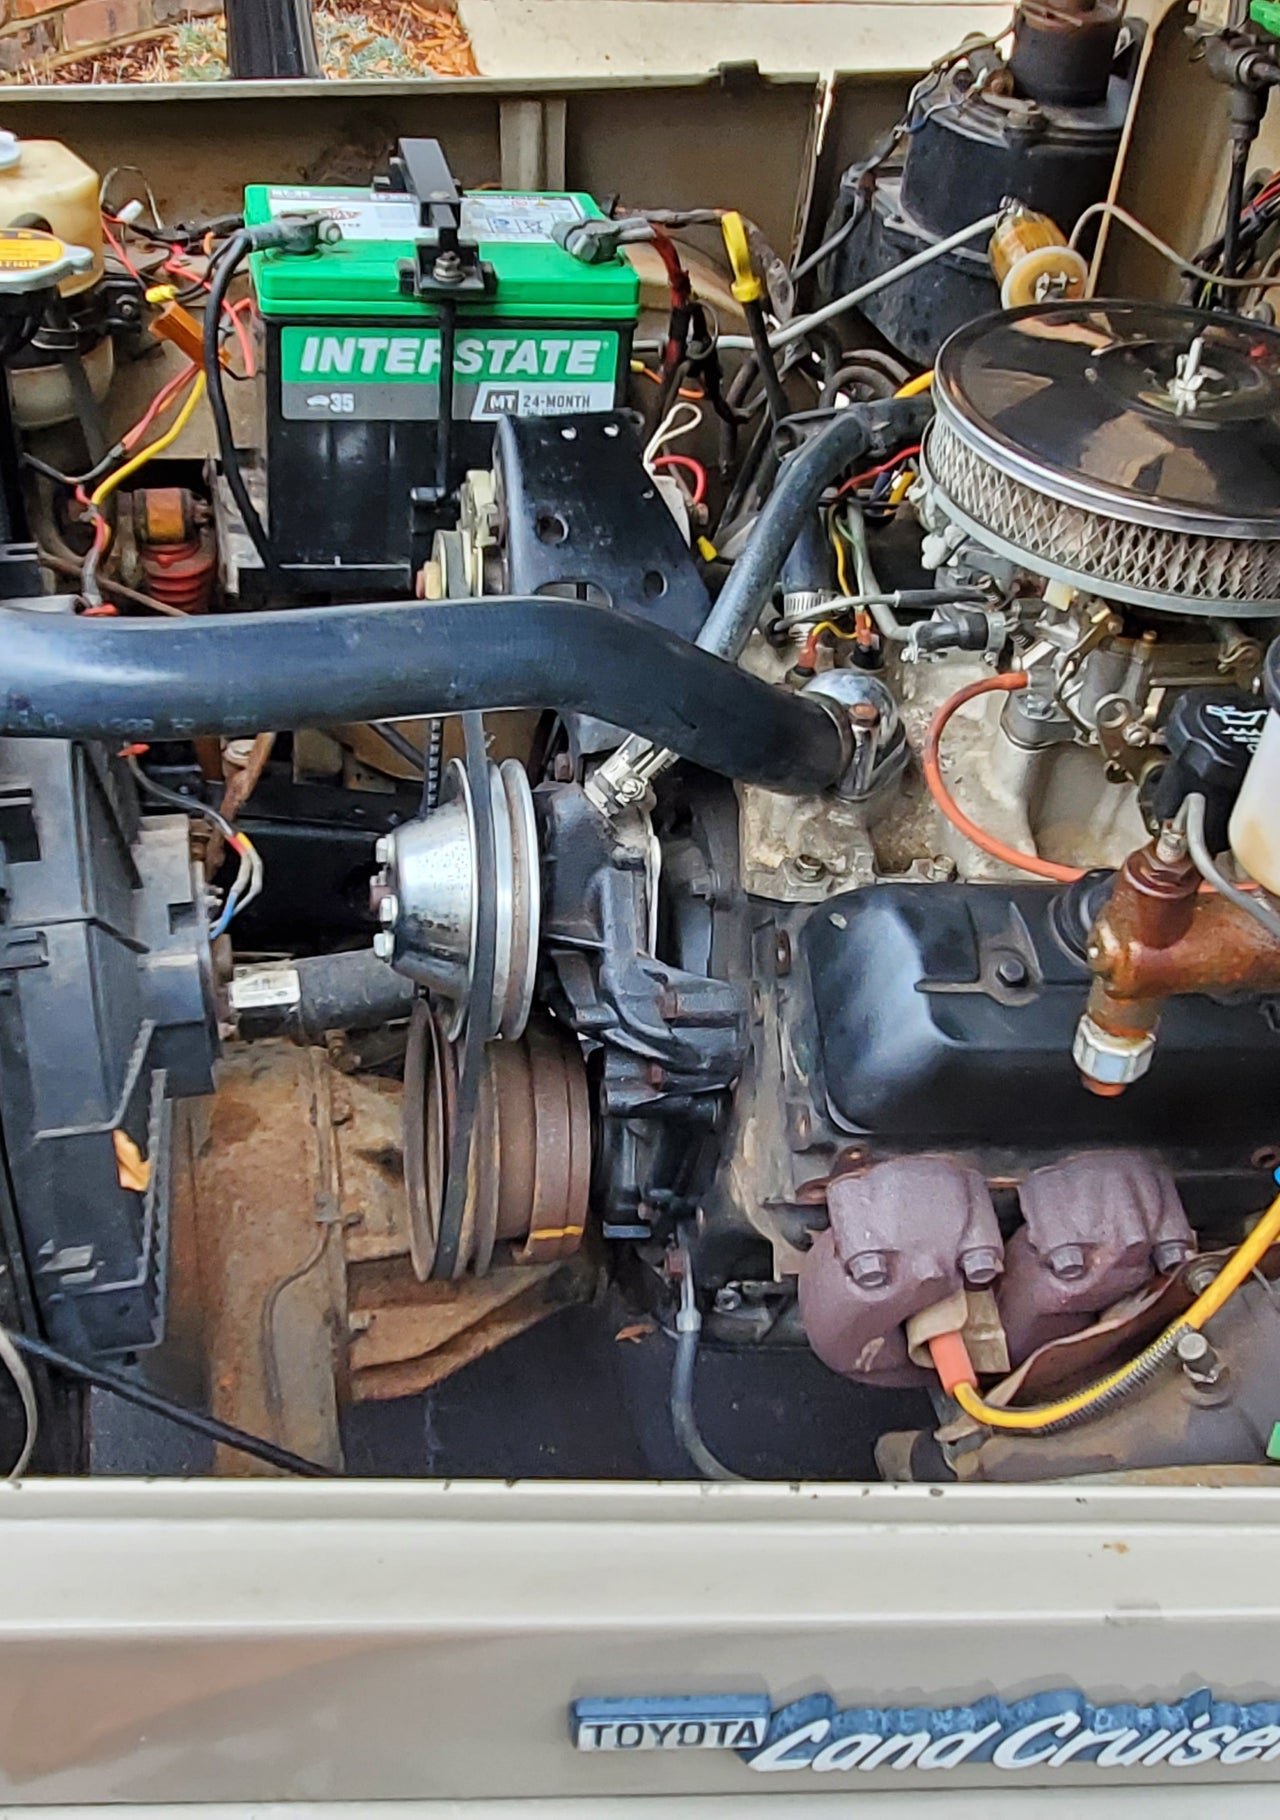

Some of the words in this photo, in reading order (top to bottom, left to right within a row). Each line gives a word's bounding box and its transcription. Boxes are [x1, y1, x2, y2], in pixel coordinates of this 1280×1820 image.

[330, 392, 354, 413] 35
[489, 394, 515, 411] MT
[522, 395, 590, 409] 24-MONTH
[584, 1721, 759, 1748] TOYOTA
[748, 1719, 1001, 1772] Land
